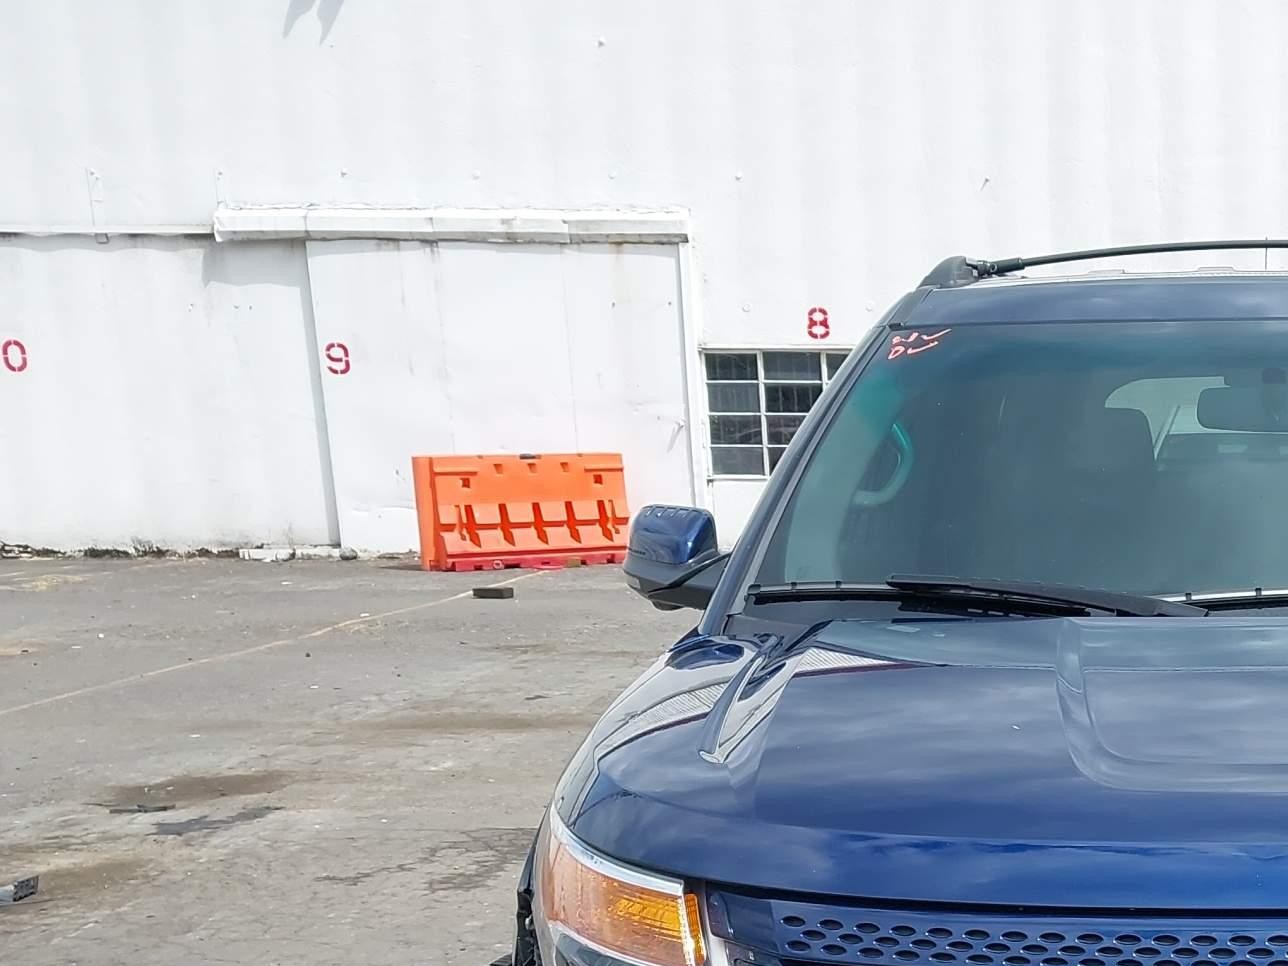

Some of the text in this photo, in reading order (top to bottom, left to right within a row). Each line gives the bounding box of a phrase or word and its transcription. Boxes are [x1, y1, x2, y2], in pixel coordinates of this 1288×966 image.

[807, 306, 830, 340] 8
[2, 339, 28, 373] 0
[325, 342, 350, 375] 9
